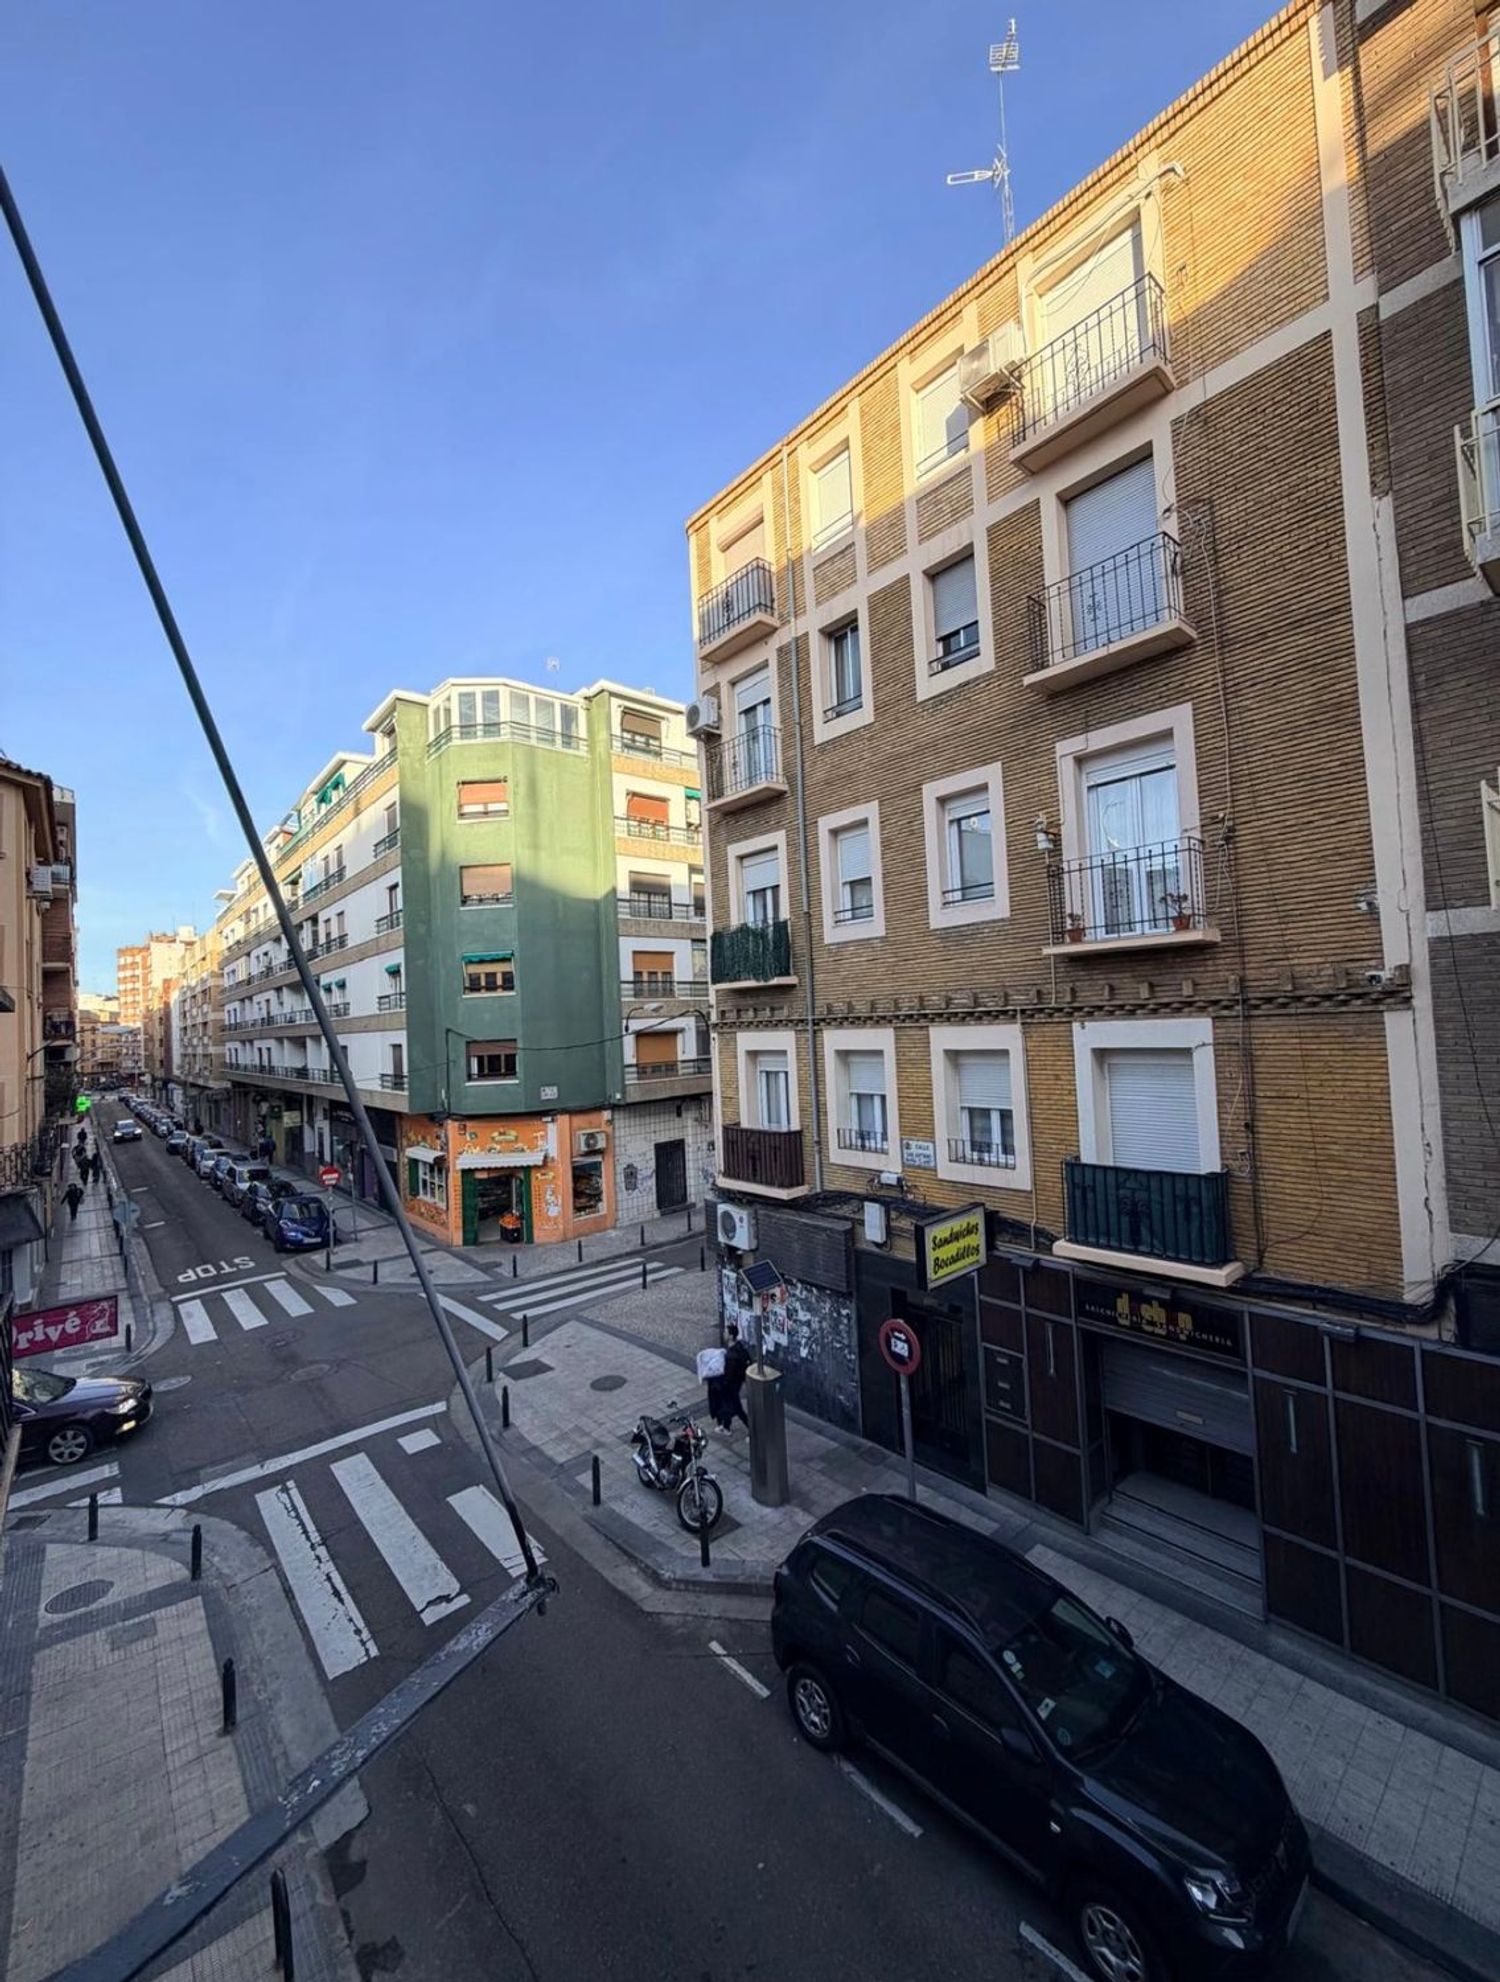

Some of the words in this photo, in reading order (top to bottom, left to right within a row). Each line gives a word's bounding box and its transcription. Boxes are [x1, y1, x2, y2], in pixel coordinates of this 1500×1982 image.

[931, 1221, 979, 1251] Sandwiches
[177, 1256, 256, 1283] STOP
[933, 1243, 980, 1275] Bocadillos
